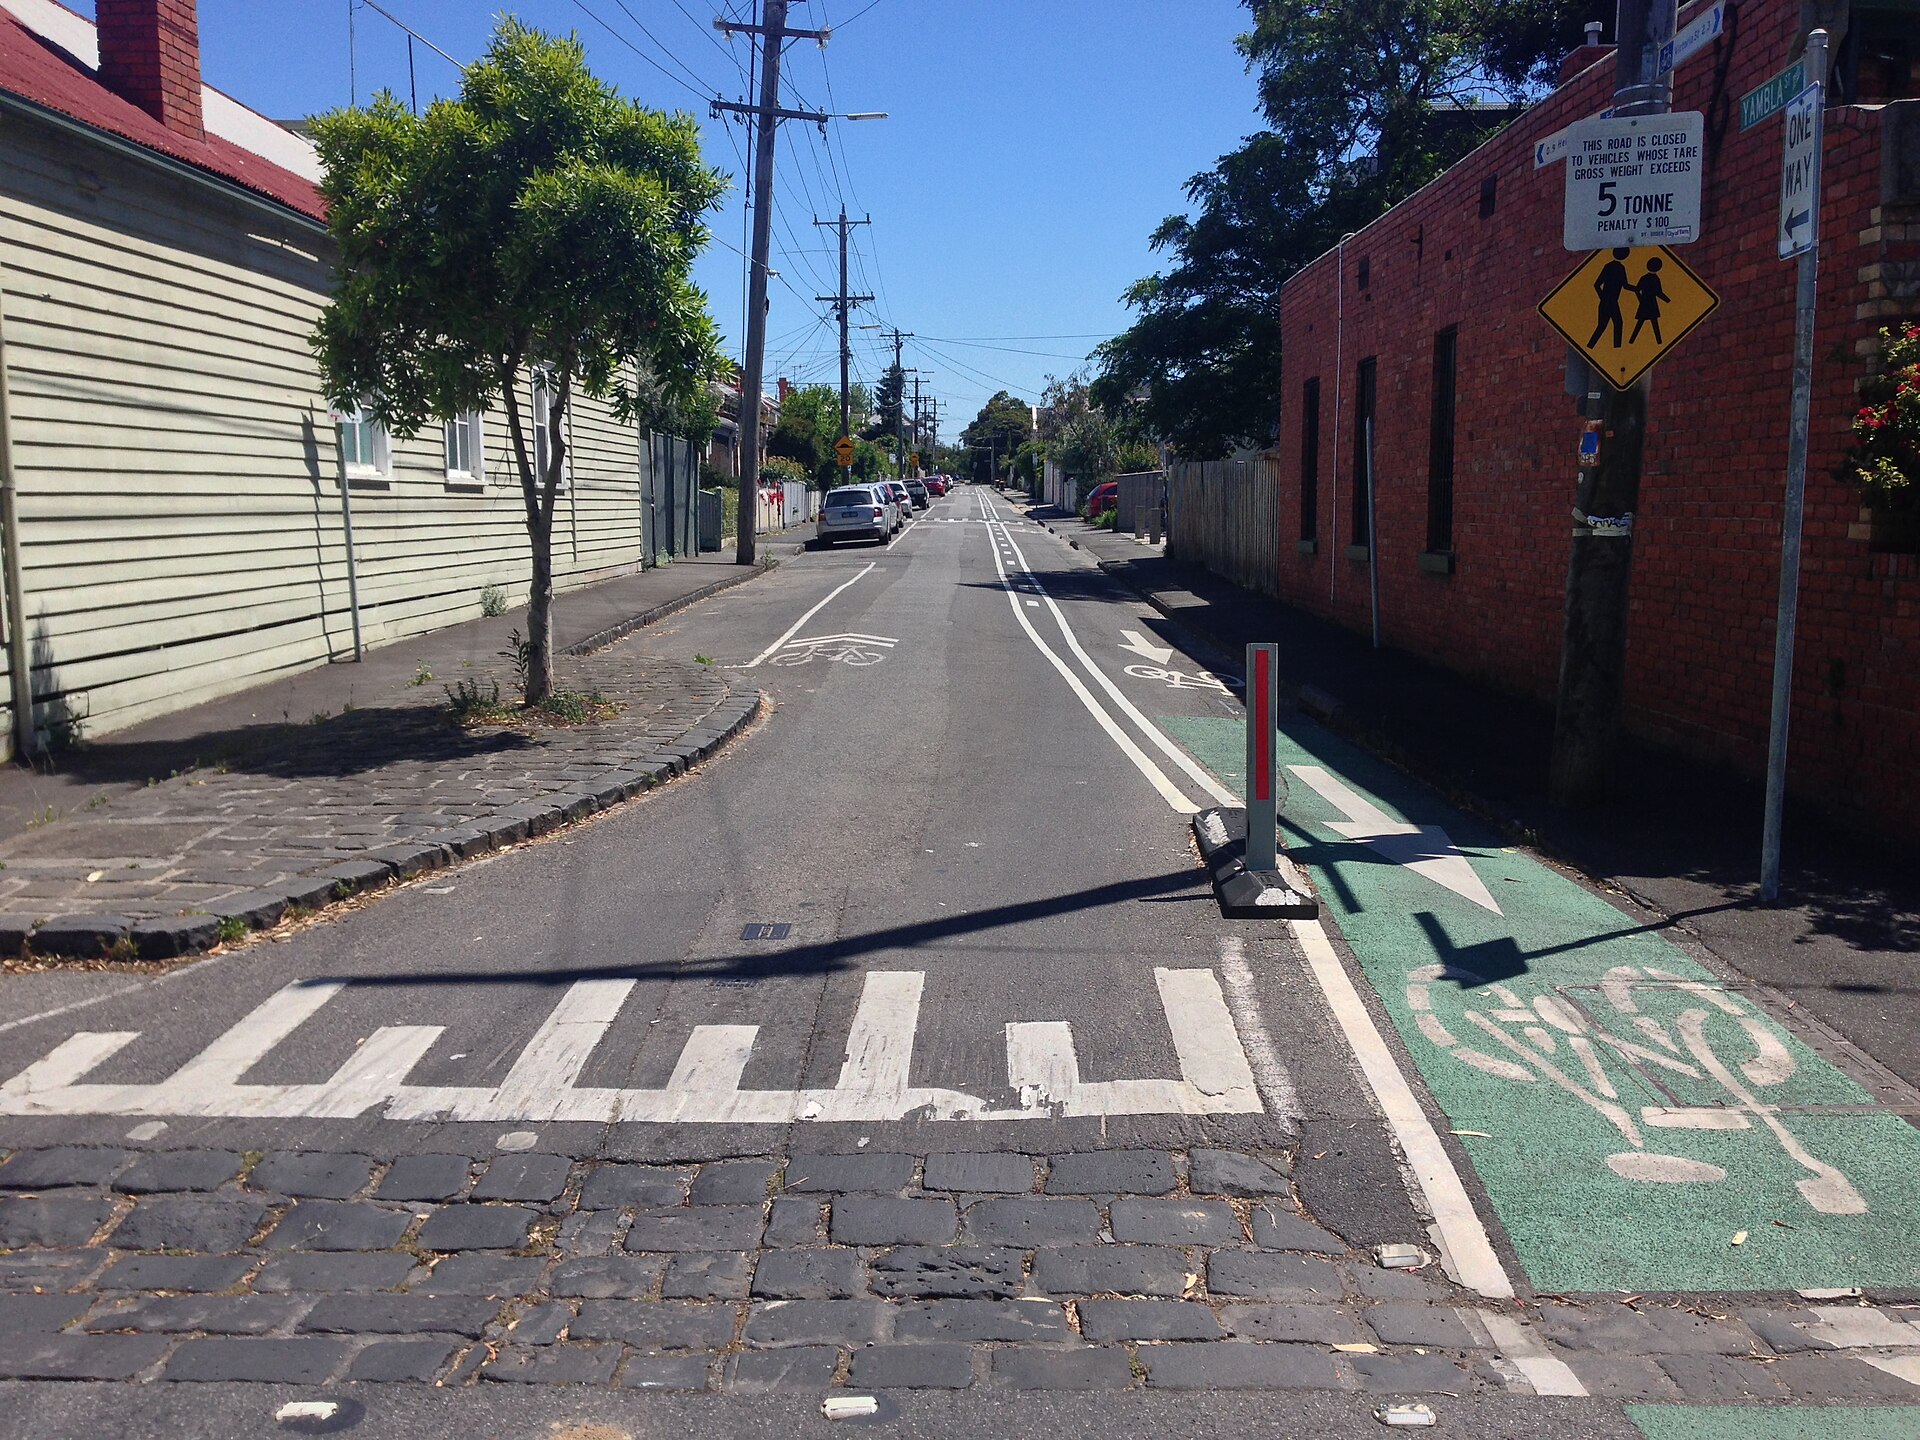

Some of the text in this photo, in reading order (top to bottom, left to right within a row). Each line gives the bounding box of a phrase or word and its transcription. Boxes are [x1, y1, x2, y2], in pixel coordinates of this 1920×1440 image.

[1743, 79, 1783, 126] YAMBLA
[1789, 103, 1812, 149] ONE
[1572, 146, 1698, 166] TO VEHICLES WHOSE TARE
[1583, 132, 1687, 152] THIS ROAD IS CLOSED
[1574, 160, 1691, 180] GROSS WEIGHT EXCEEDS
[1785, 152, 1812, 198] WAY
[1597, 181, 1674, 217] 5 TONNE
[1597, 218, 1638, 232] PENALTY
